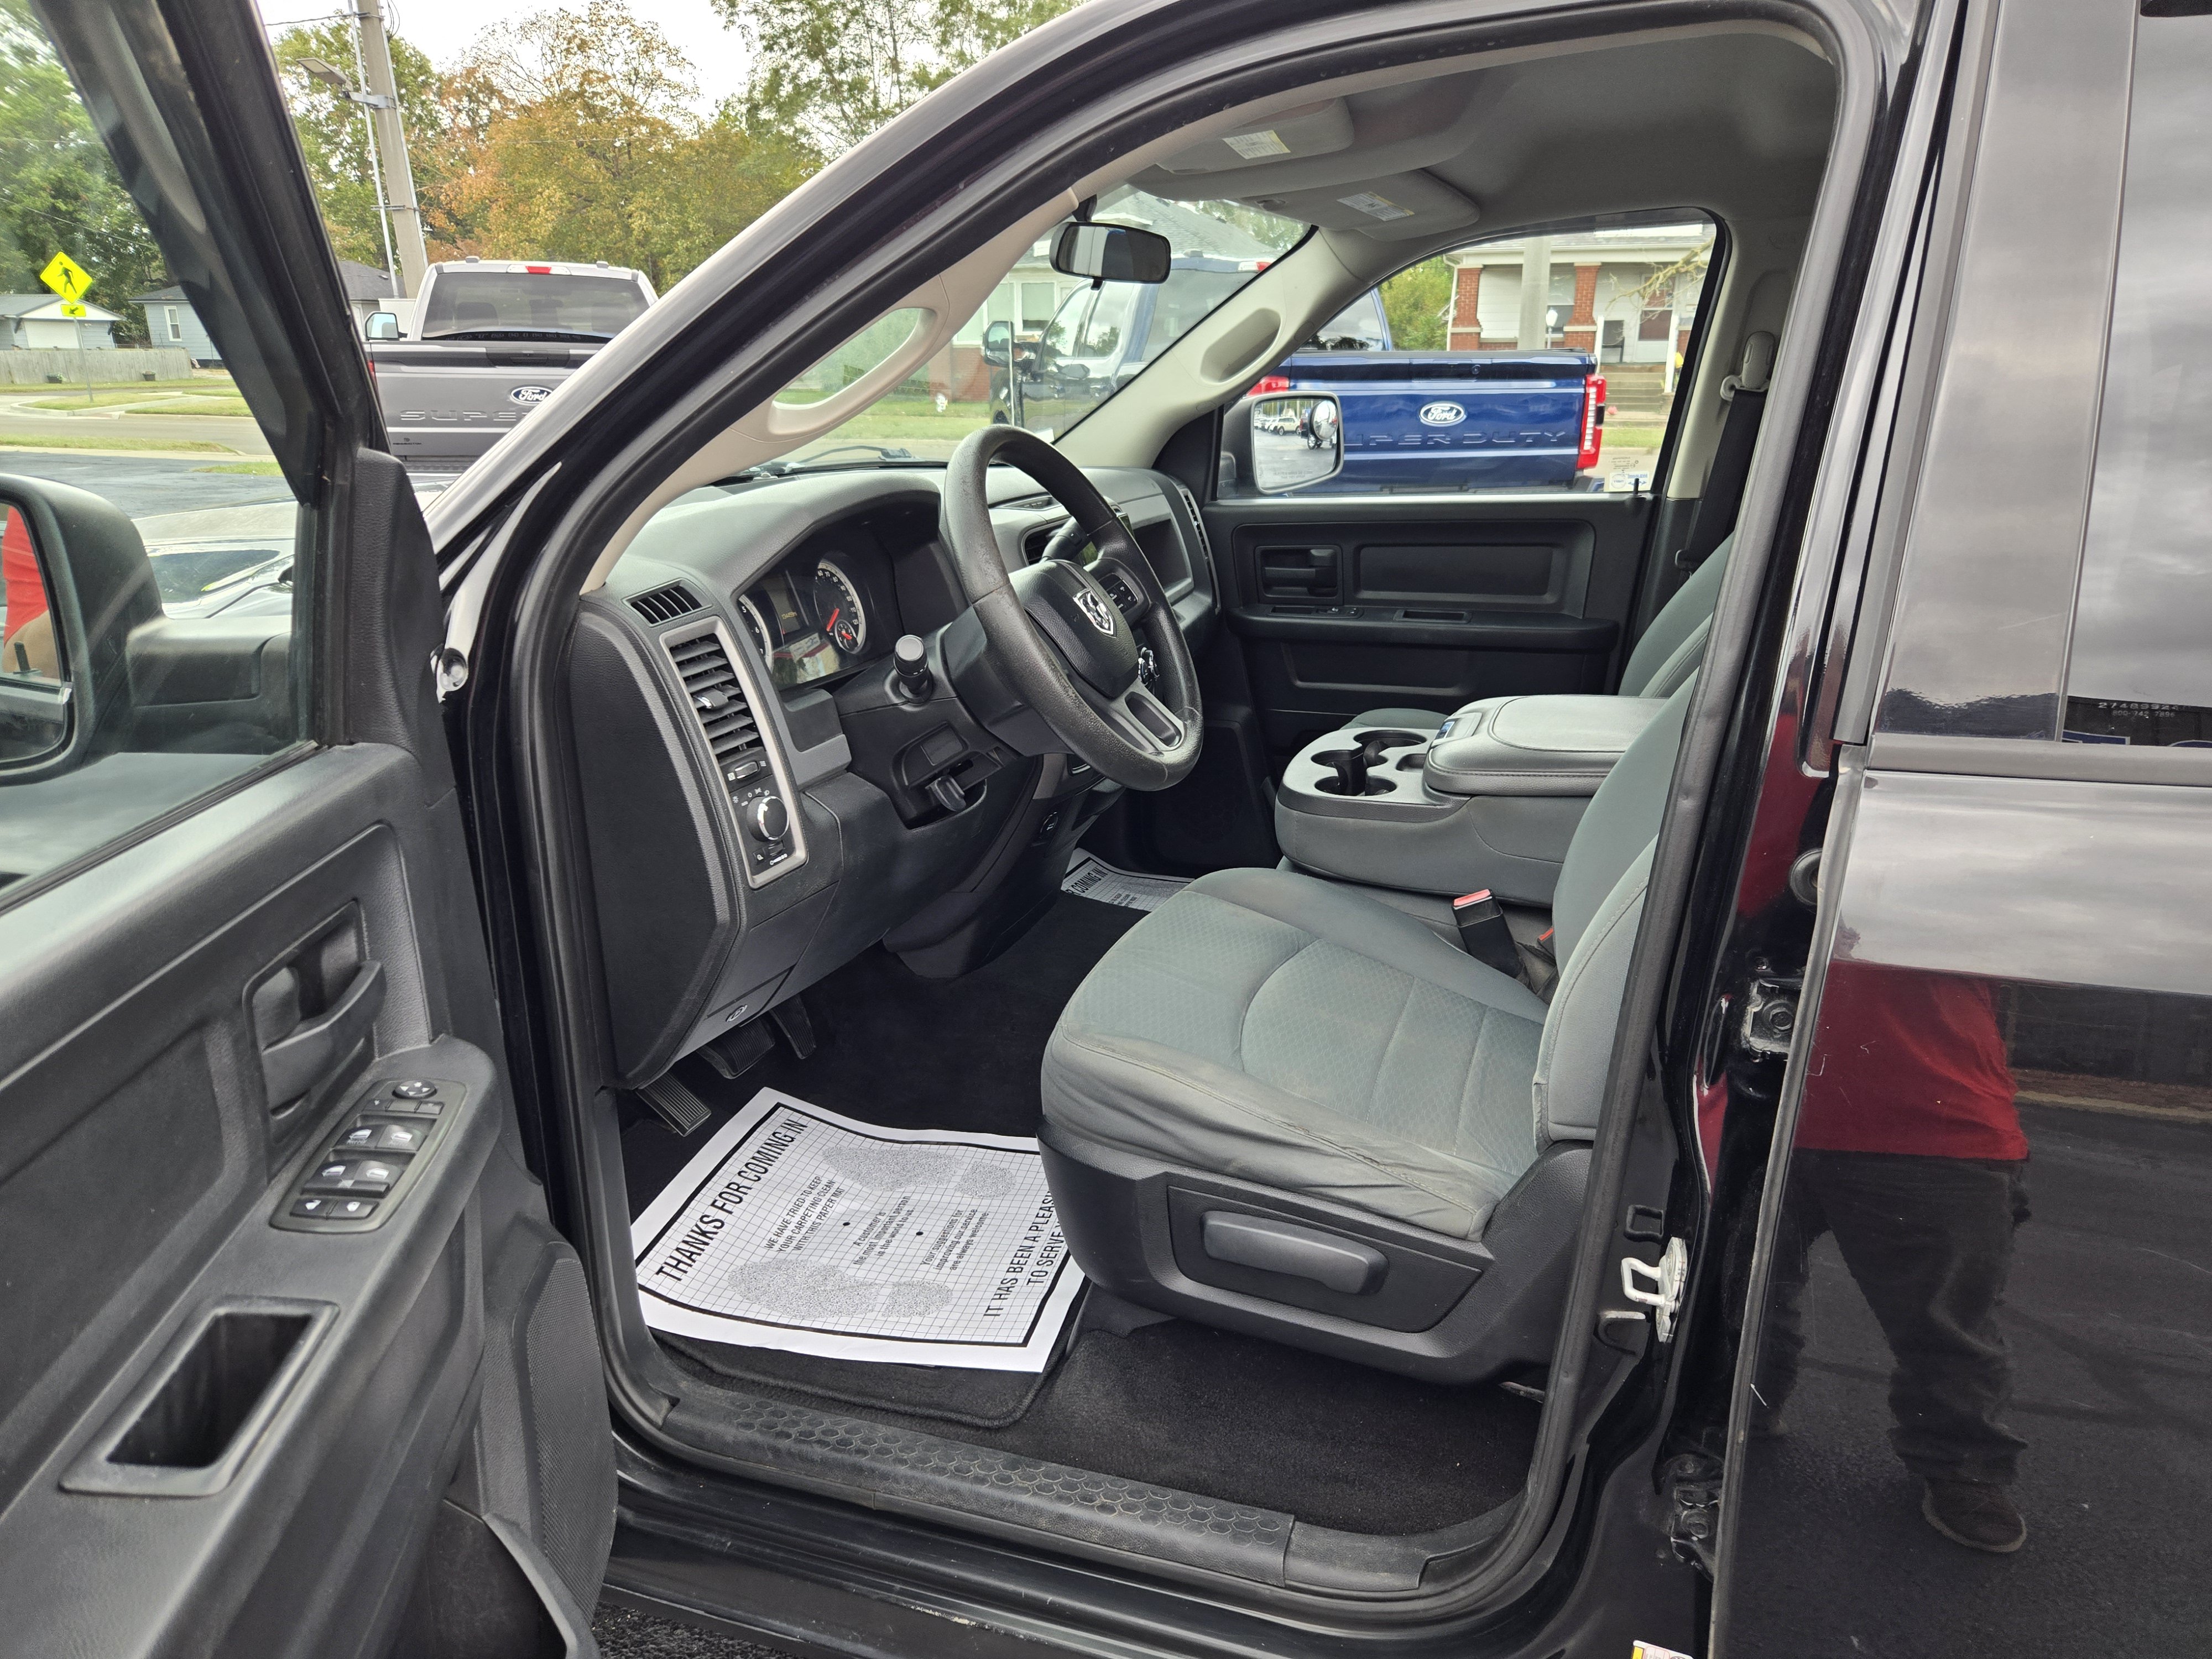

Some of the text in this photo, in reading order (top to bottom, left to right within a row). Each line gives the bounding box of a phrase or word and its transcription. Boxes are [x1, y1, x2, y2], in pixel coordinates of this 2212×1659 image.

[519, 389, 547, 401] Ford
[400, 410, 529, 421] SUPE
[1427, 406, 1457, 421] Ford
[1344, 431, 1566, 446] UPER DUTY
[1071, 872, 1102, 893] COMING
[1092, 867, 1108, 878] IN
[655, 1119, 808, 1281] THANKS FOR COMING IN
[764, 1237, 779, 1249] WE
[773, 1218, 792, 1237] HAVE
[786, 1197, 806, 1218] TRIED
[807, 1176, 822, 1191] KEEP
[1028, 1191, 1055, 1232] PLEAS
[776, 1180, 836, 1253] YOUR CARPETING CLEAN
[792, 1187, 846, 1251] WITH THIS PAPER MAT
[853, 1196, 911, 1265] the most important person
[858, 1214, 881, 1241] customer
[879, 1239, 893, 1249] the
[888, 1223, 904, 1238] world
[920, 1251, 937, 1265] Your
[932, 1218, 958, 1251] suggestions
[933, 1209, 978, 1270] improving our service
[950, 1261, 961, 1270] are
[956, 1239, 974, 1259] always
[1005, 1245, 1036, 1273] BEEN
[1026, 1231, 1065, 1286] TO SERVE
[990, 1277, 1018, 1300] HAS
[983, 1305, 1004, 1317] IT
